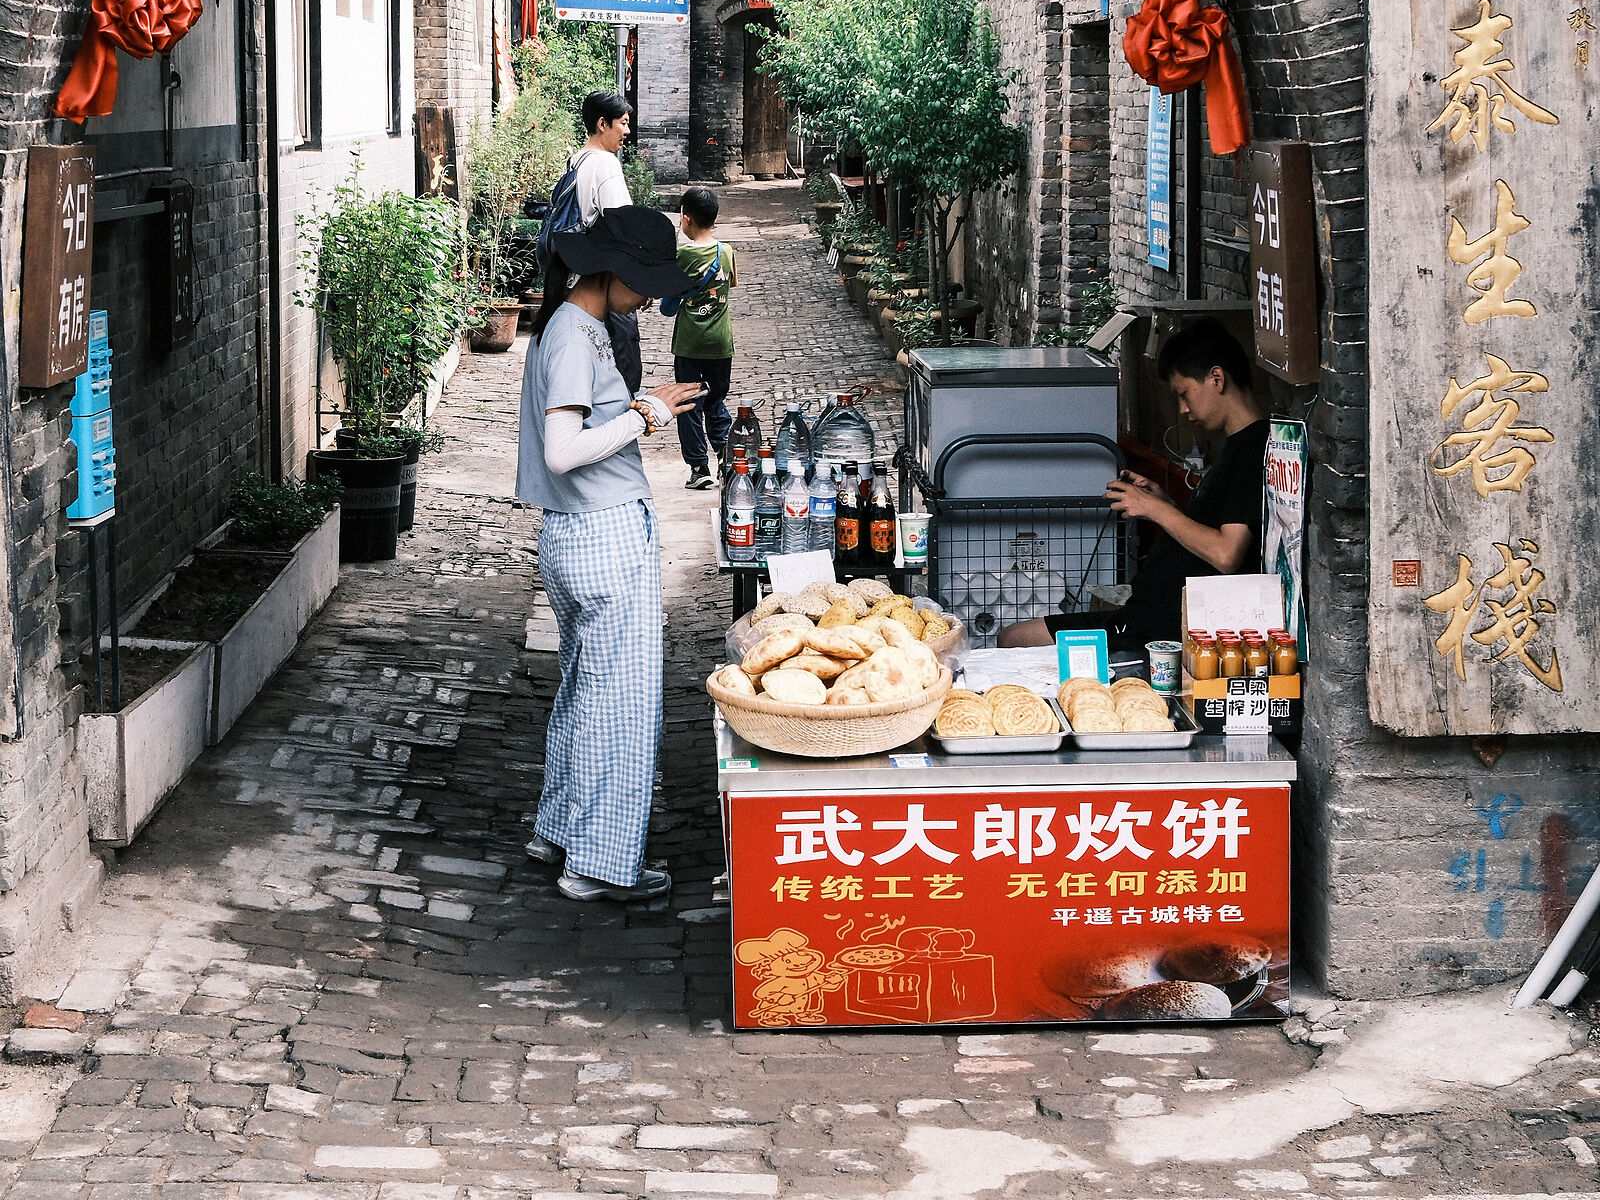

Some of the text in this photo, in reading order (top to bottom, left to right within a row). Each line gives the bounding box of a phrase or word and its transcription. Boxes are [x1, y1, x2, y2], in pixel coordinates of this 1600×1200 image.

[580, 11, 622, 21] 天泰生客栈
[62, 183, 88, 253] 今日
[1252, 182, 1280, 249] 今日
[58, 274, 84, 349] 有房
[1256, 266, 1284, 338] 有房
[1205, 698, 1290, 718] 生榨沙棘
[1229, 679, 1267, 697] 吕梁
[773, 797, 1252, 867] 武大郎炊饼
[769, 867, 1248, 903] 传统工艺 无任何添加
[1050, 904, 1246, 927] 平遥古城特色
